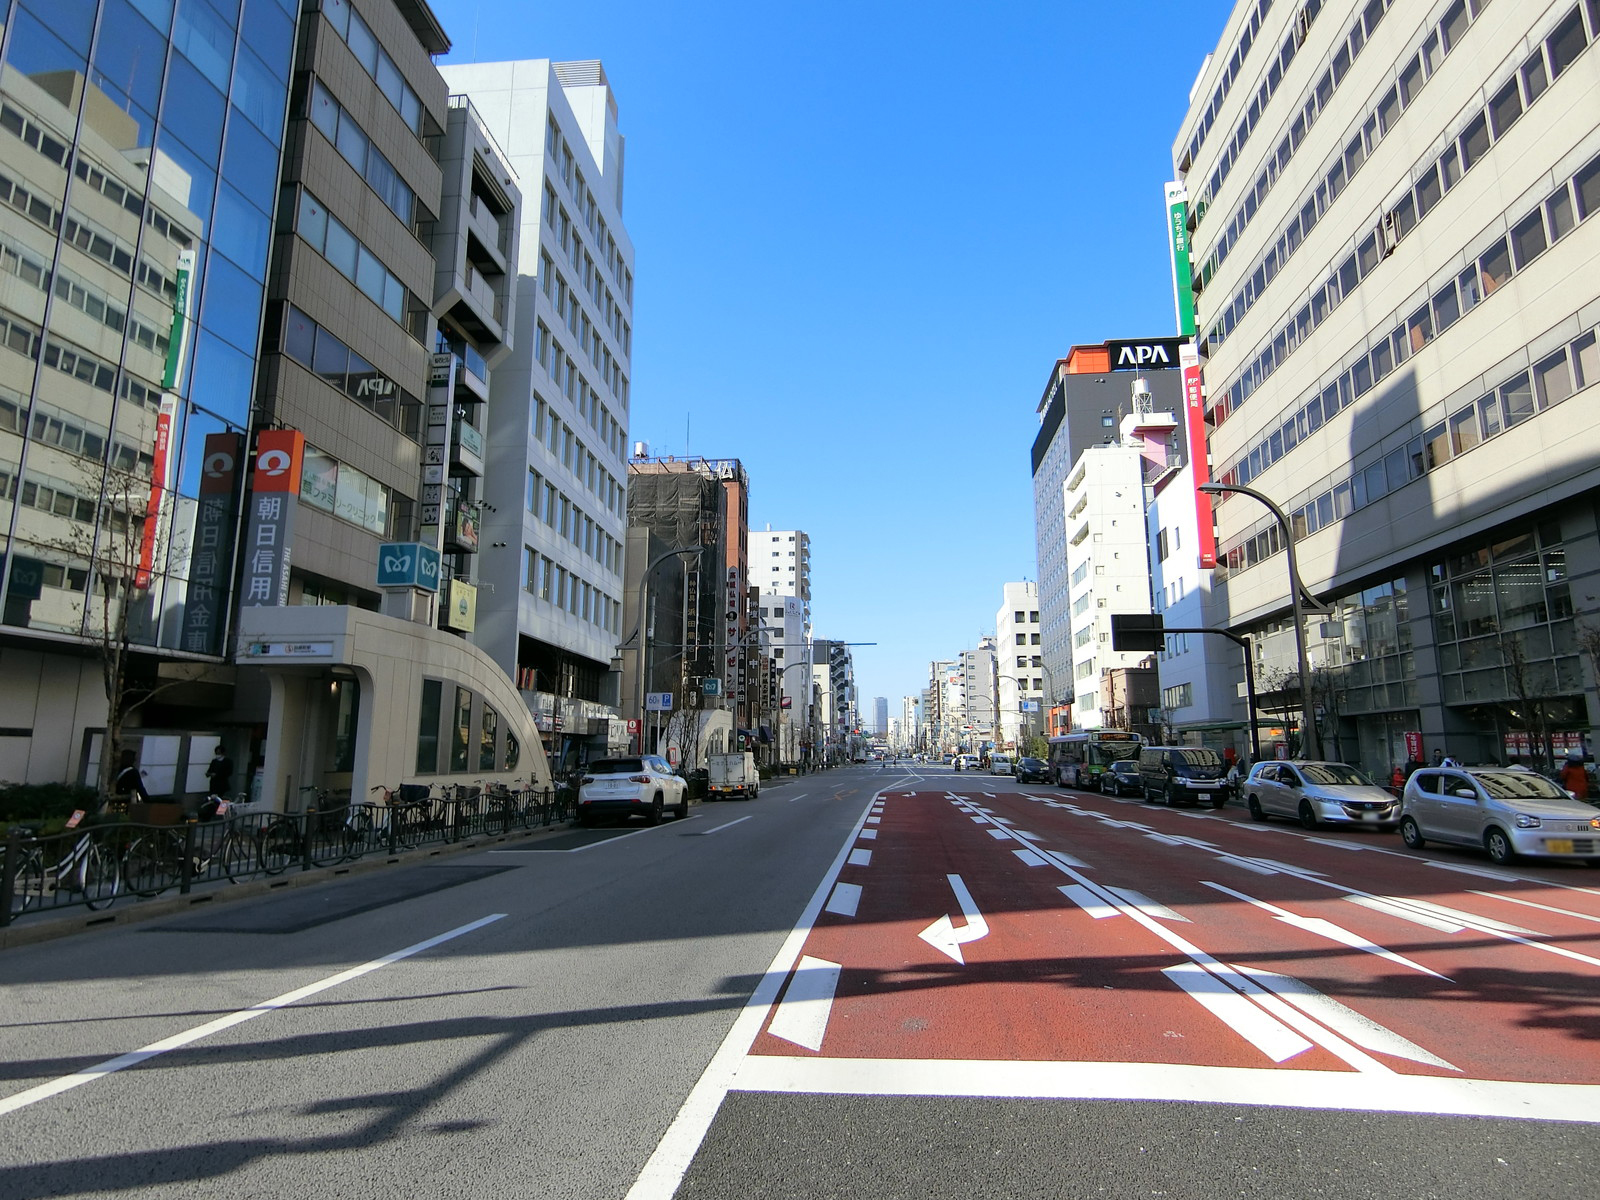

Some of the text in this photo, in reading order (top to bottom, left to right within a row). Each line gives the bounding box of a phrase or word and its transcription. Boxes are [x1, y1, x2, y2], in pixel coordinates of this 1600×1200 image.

[1174, 212, 1185, 252] ゆうちょ銀行
[1118, 345, 1170, 365] APA
[1189, 386, 1199, 408] 郵便局
[248, 496, 282, 608] 朝日信用
[283, 546, 292, 564] THE
[280, 564, 289, 591] ASAHI
[748, 658, 759, 687] 中川
